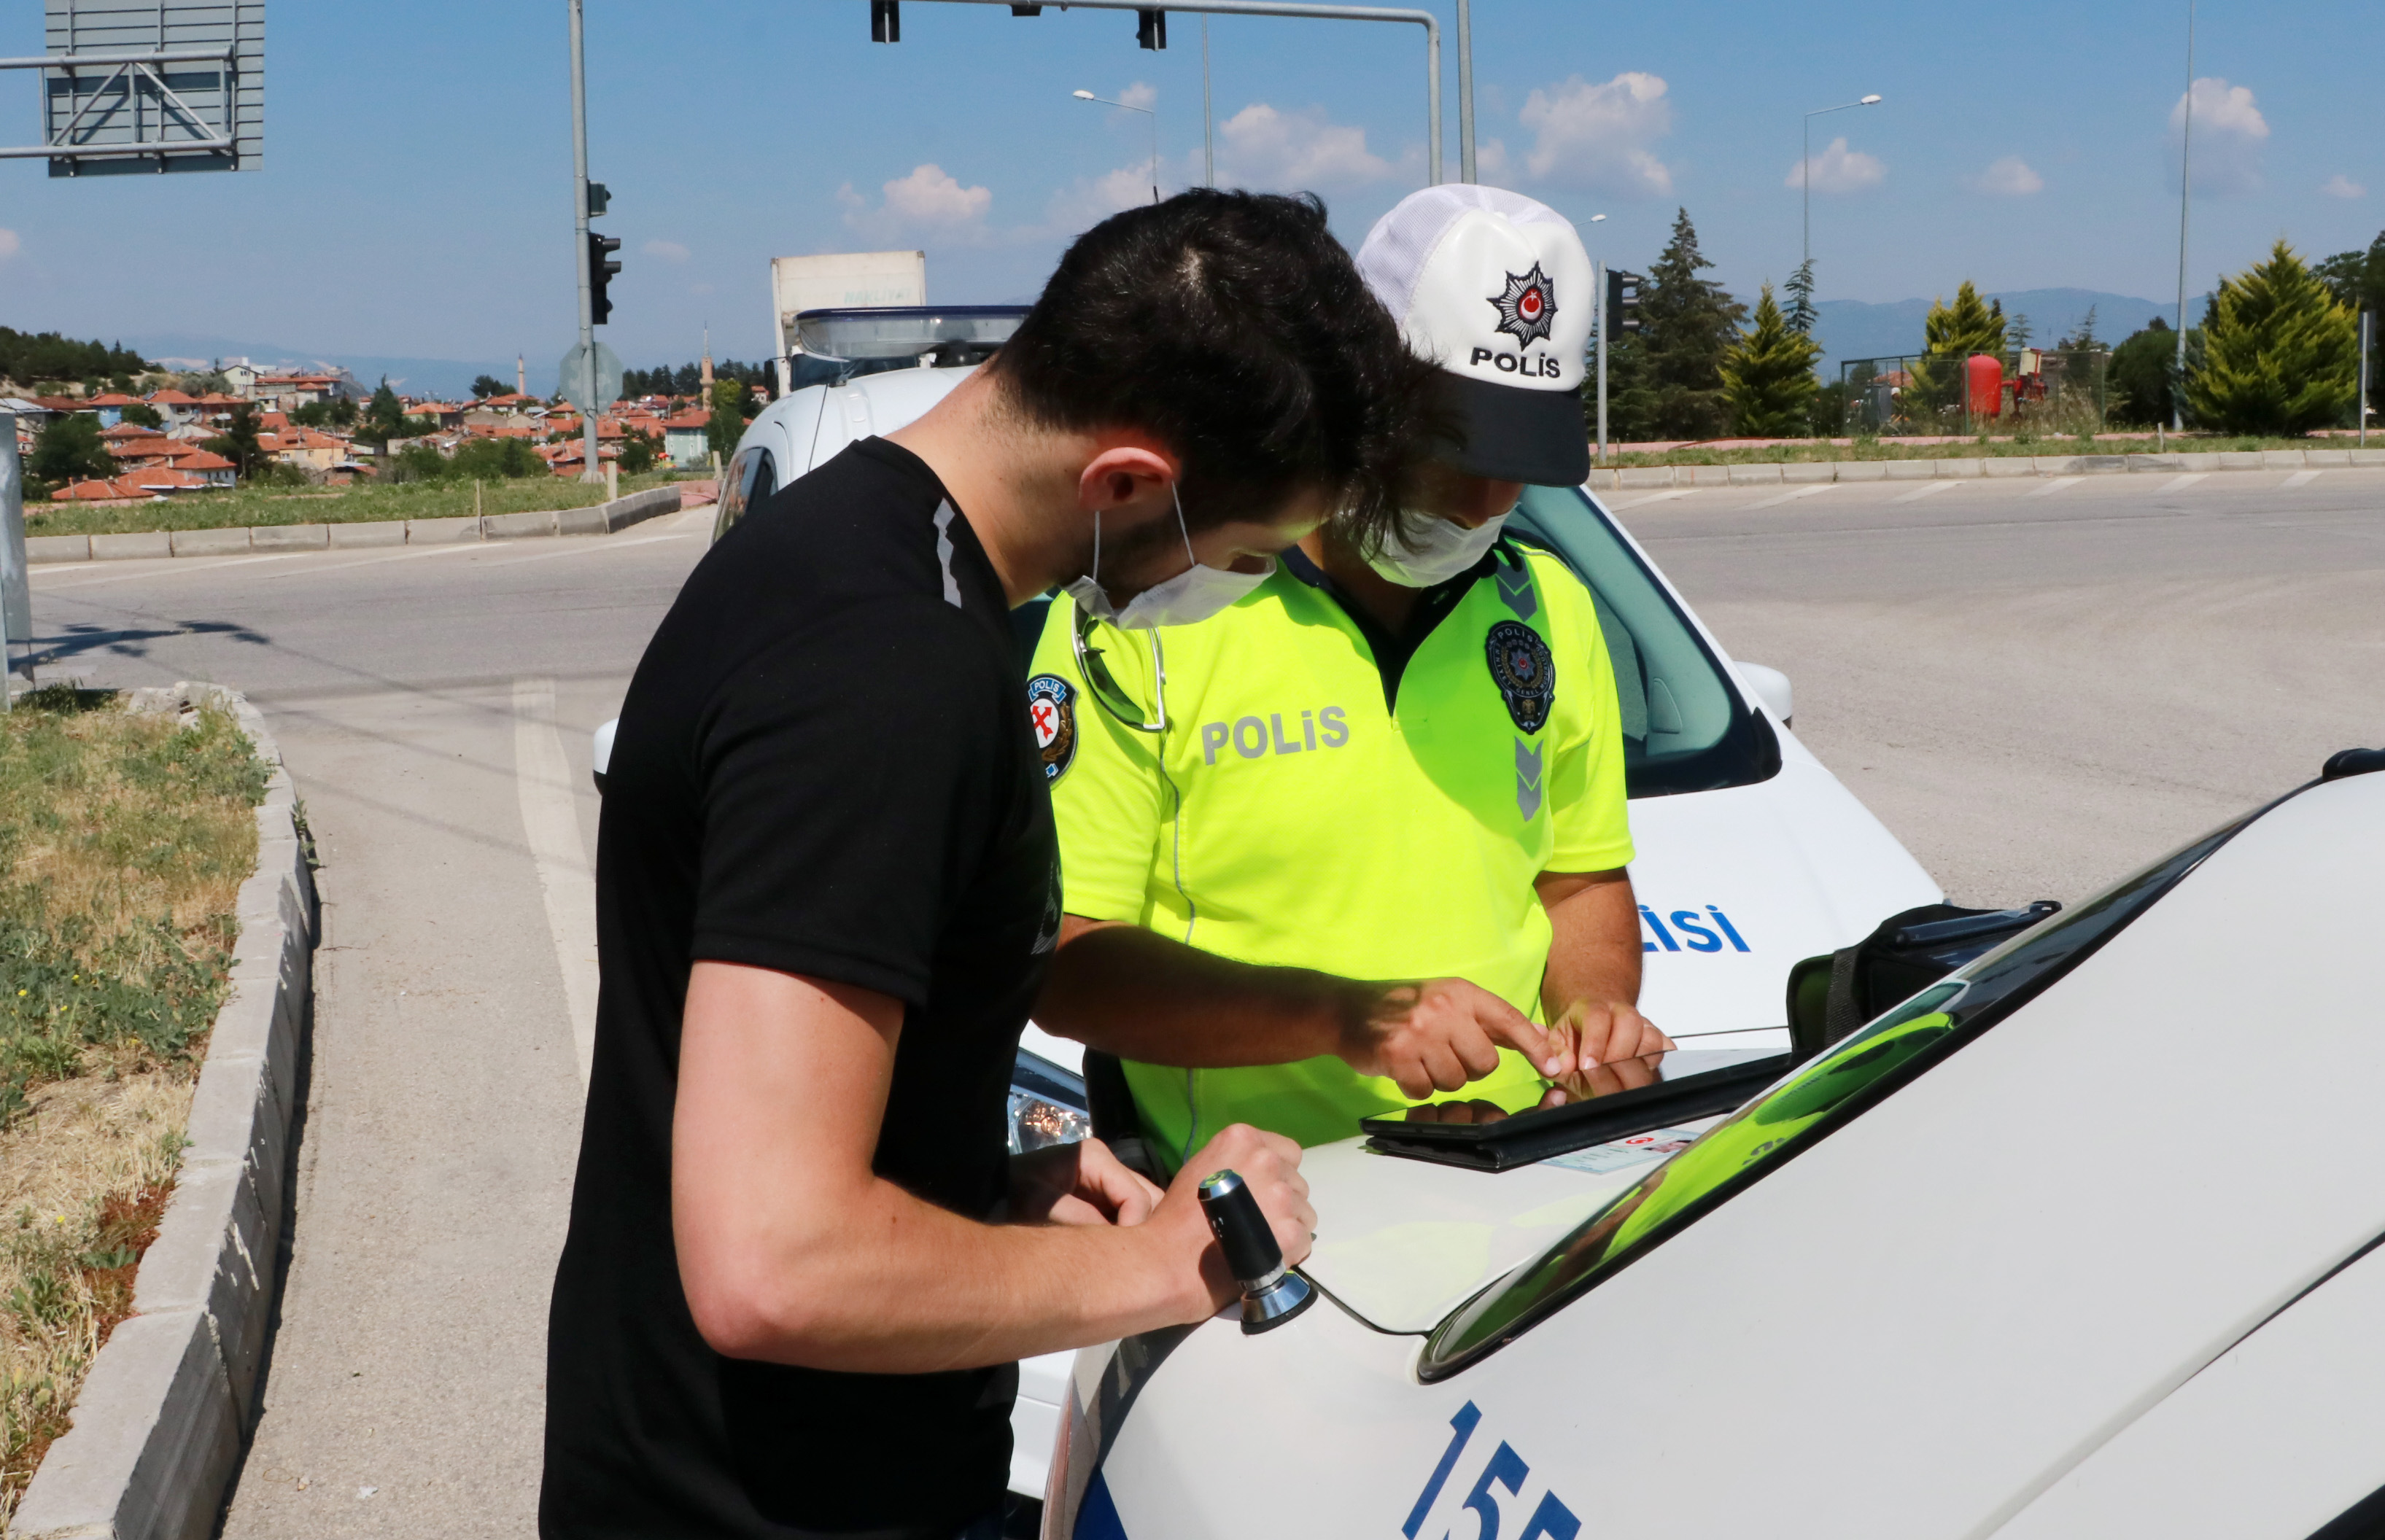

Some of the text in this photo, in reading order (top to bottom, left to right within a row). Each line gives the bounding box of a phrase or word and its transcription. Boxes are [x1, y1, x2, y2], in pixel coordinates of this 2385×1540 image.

[1470, 347, 1560, 378] POLİS
[1497, 628, 1533, 642] POLİS
[1034, 679, 1060, 693] POLİS
[1201, 706, 1349, 766] POLİS
